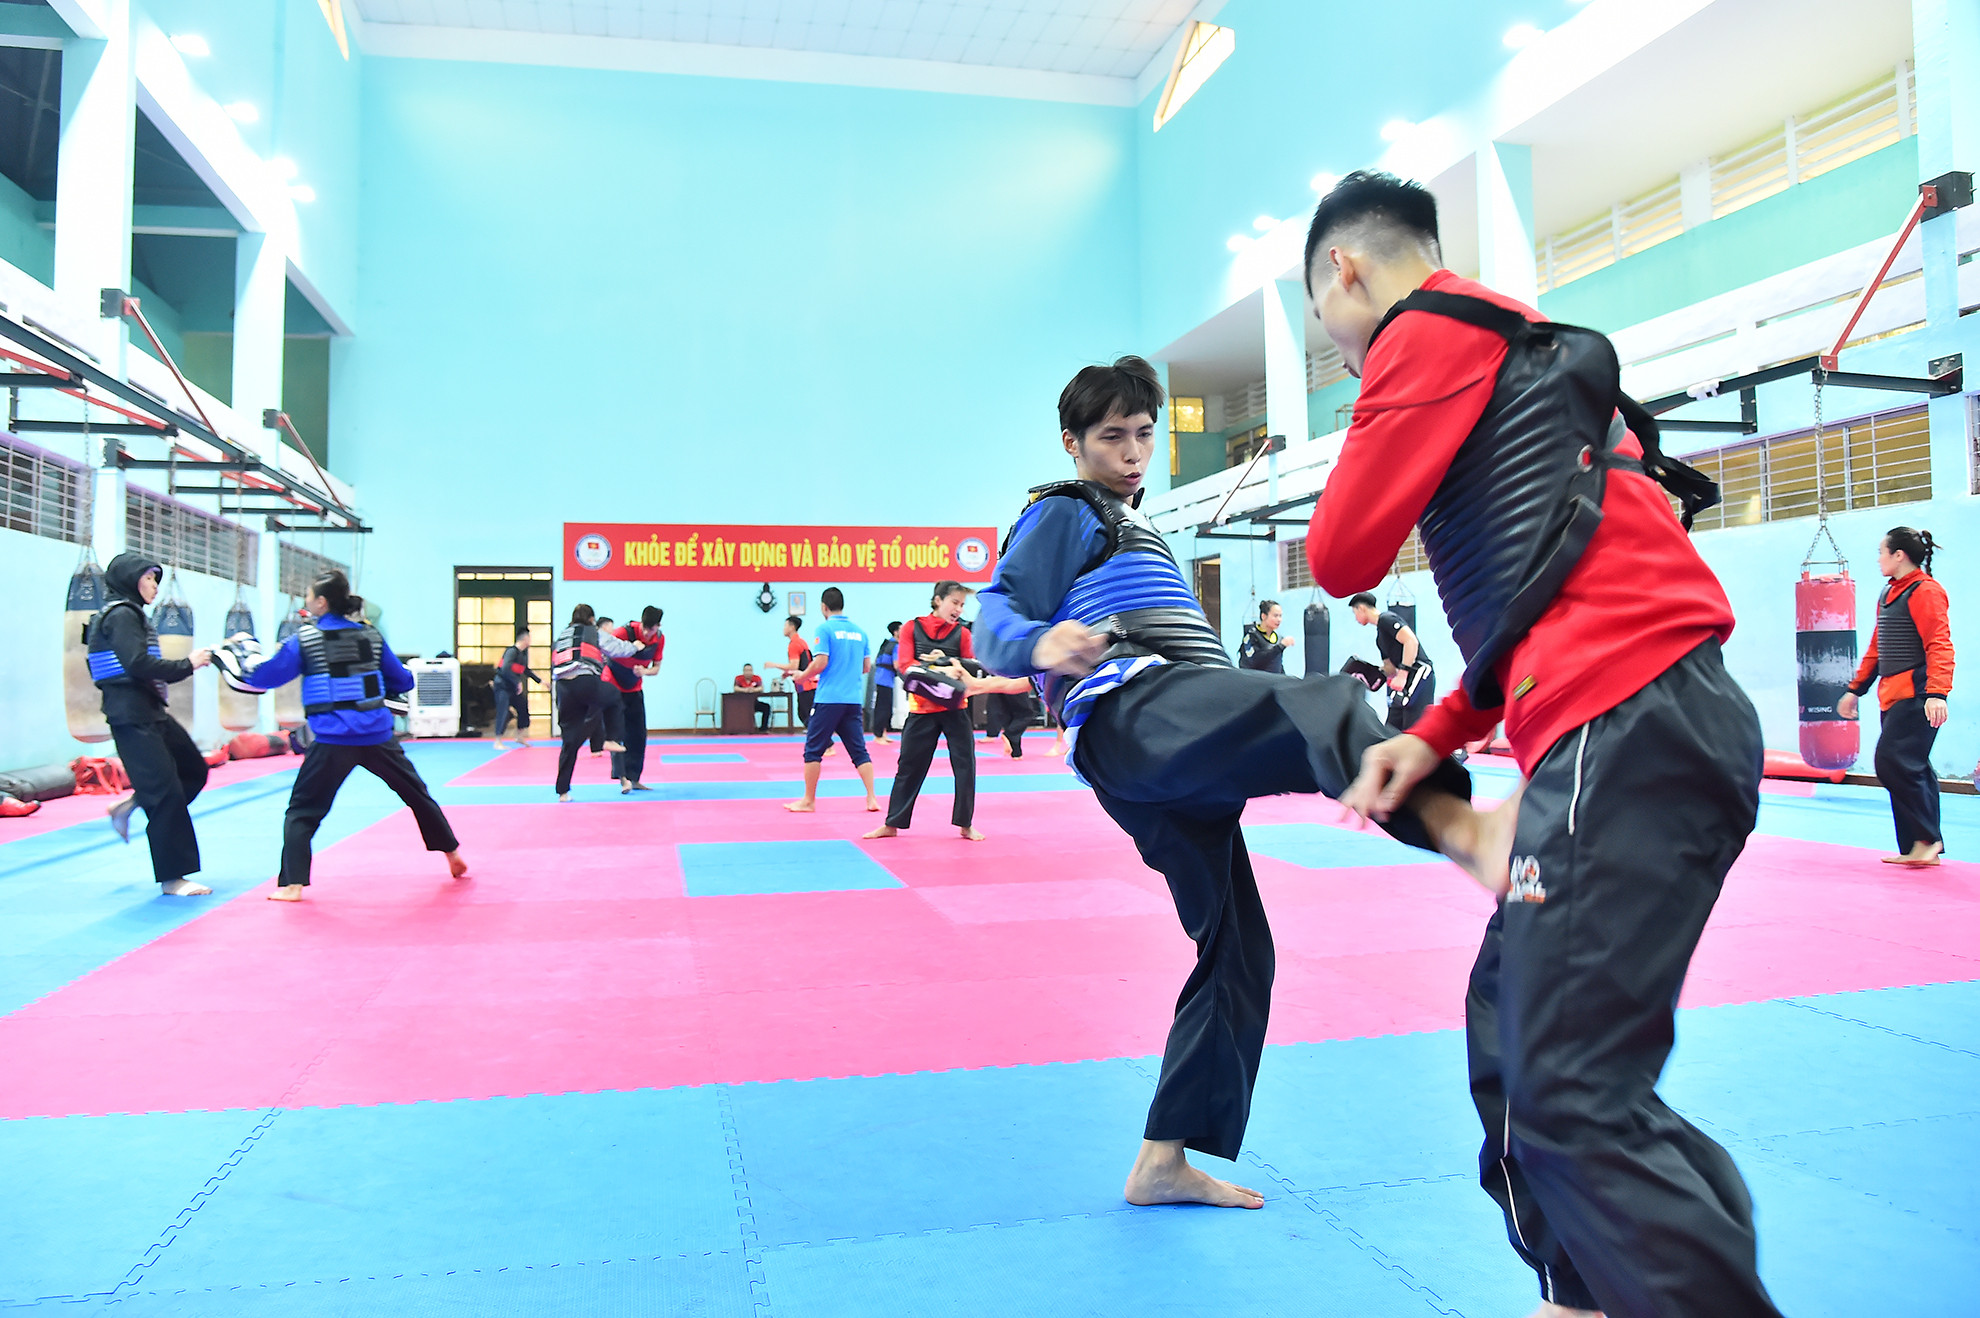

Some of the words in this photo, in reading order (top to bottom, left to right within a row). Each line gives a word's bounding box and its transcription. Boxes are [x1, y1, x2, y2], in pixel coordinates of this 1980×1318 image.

[624, 533, 671, 567] KHỎE
[674, 531, 698, 567] ĐỂ
[701, 537, 736, 567] XÂY
[740, 539, 788, 572] DỰNG
[791, 538, 814, 567] VÀ
[817, 535, 852, 568] BẢO
[855, 538, 878, 573] VỆ
[880, 534, 903, 568] TỔ
[905, 536, 950, 571] QUỐC
